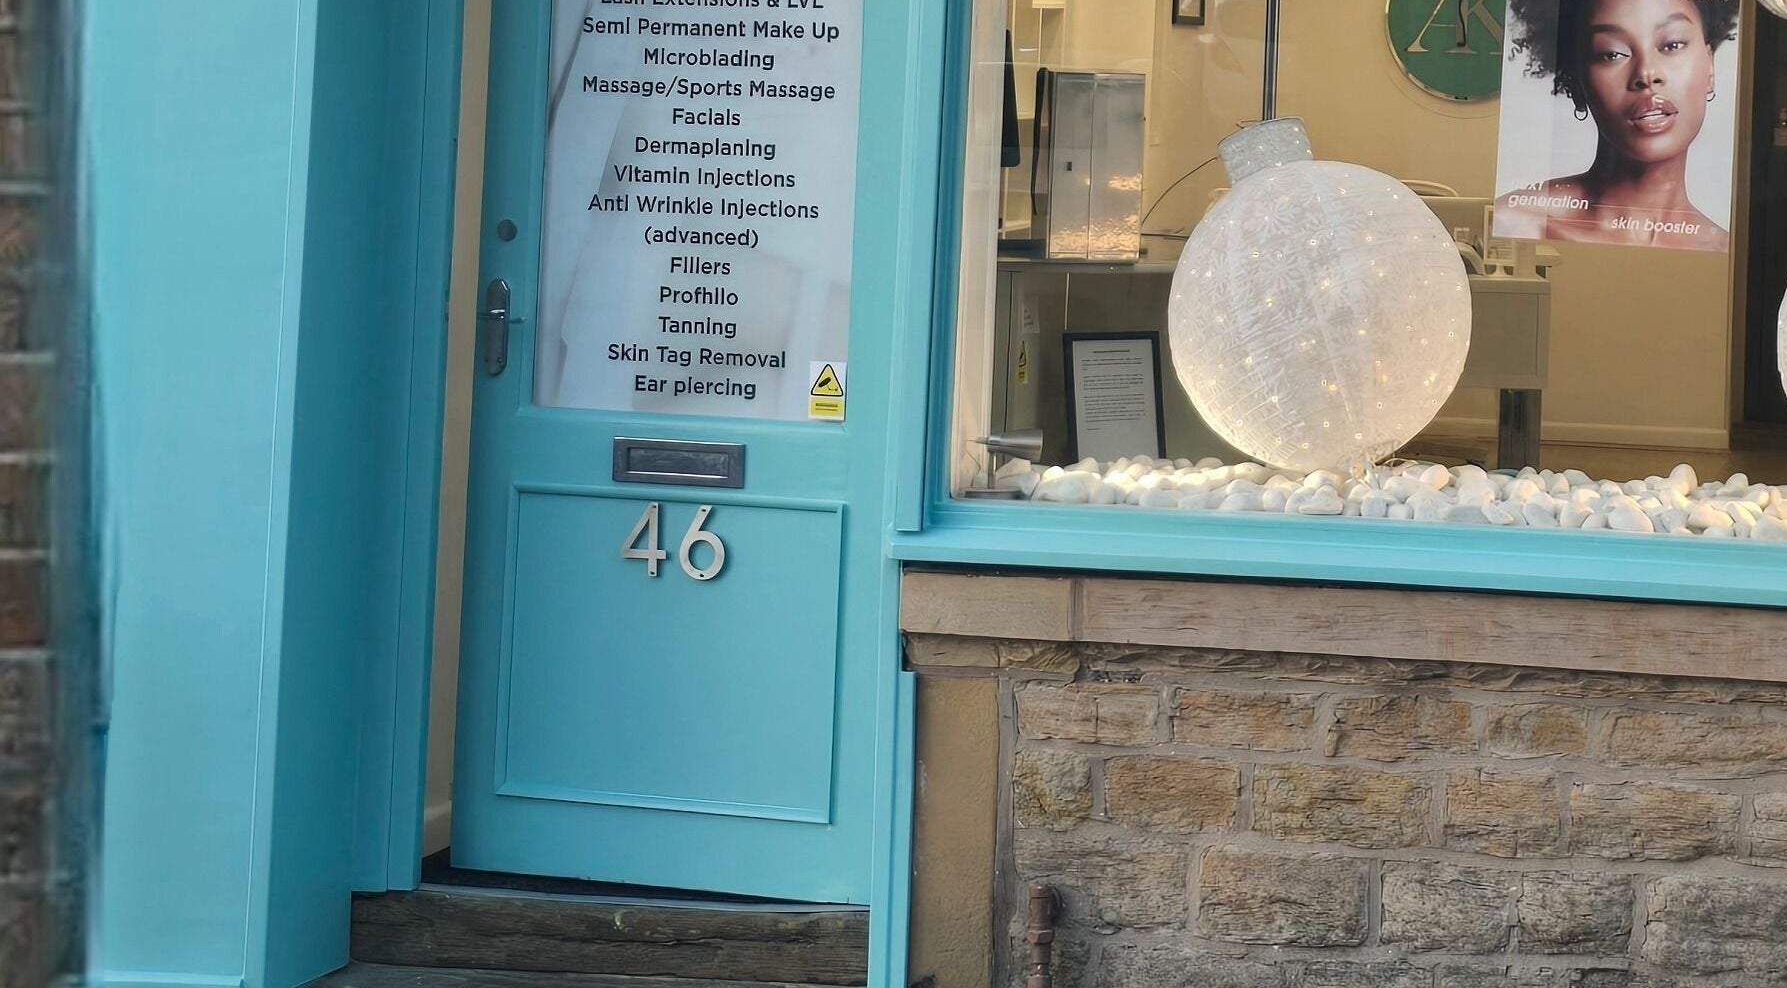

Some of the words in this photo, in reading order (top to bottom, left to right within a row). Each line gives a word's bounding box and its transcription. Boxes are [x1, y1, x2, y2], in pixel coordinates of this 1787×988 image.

[583, 17, 630, 34] Semi
[638, 18, 746, 37] Permanent
[753, 21, 805, 38] Make
[812, 22, 840, 43] Up
[644, 48, 775, 70] Microblading
[583, 76, 742, 99] Massage/Sports
[750, 80, 836, 101] Massage
[672, 108, 741, 126] Facials
[635, 137, 776, 160] Dermaplaning
[614, 165, 690, 185] Vitamin
[698, 167, 796, 188] Injections
[587, 194, 629, 212] Anti
[637, 196, 713, 215] Wrinkle
[721, 198, 819, 220] Injections
[1508, 193, 1589, 210] generation
[644, 226, 759, 248] (advanced)
[1612, 216, 1641, 230] skin
[1644, 219, 1700, 235] booster
[670, 257, 731, 275] Fillers
[659, 287, 739, 306] Profhilo
[658, 316, 737, 339] Tanning
[608, 344, 649, 362] Skin
[656, 346, 692, 366] Tag
[700, 348, 786, 368] Removal
[634, 375, 667, 393] Ear
[674, 377, 757, 400] piercing
[620, 502, 725, 580] 46
